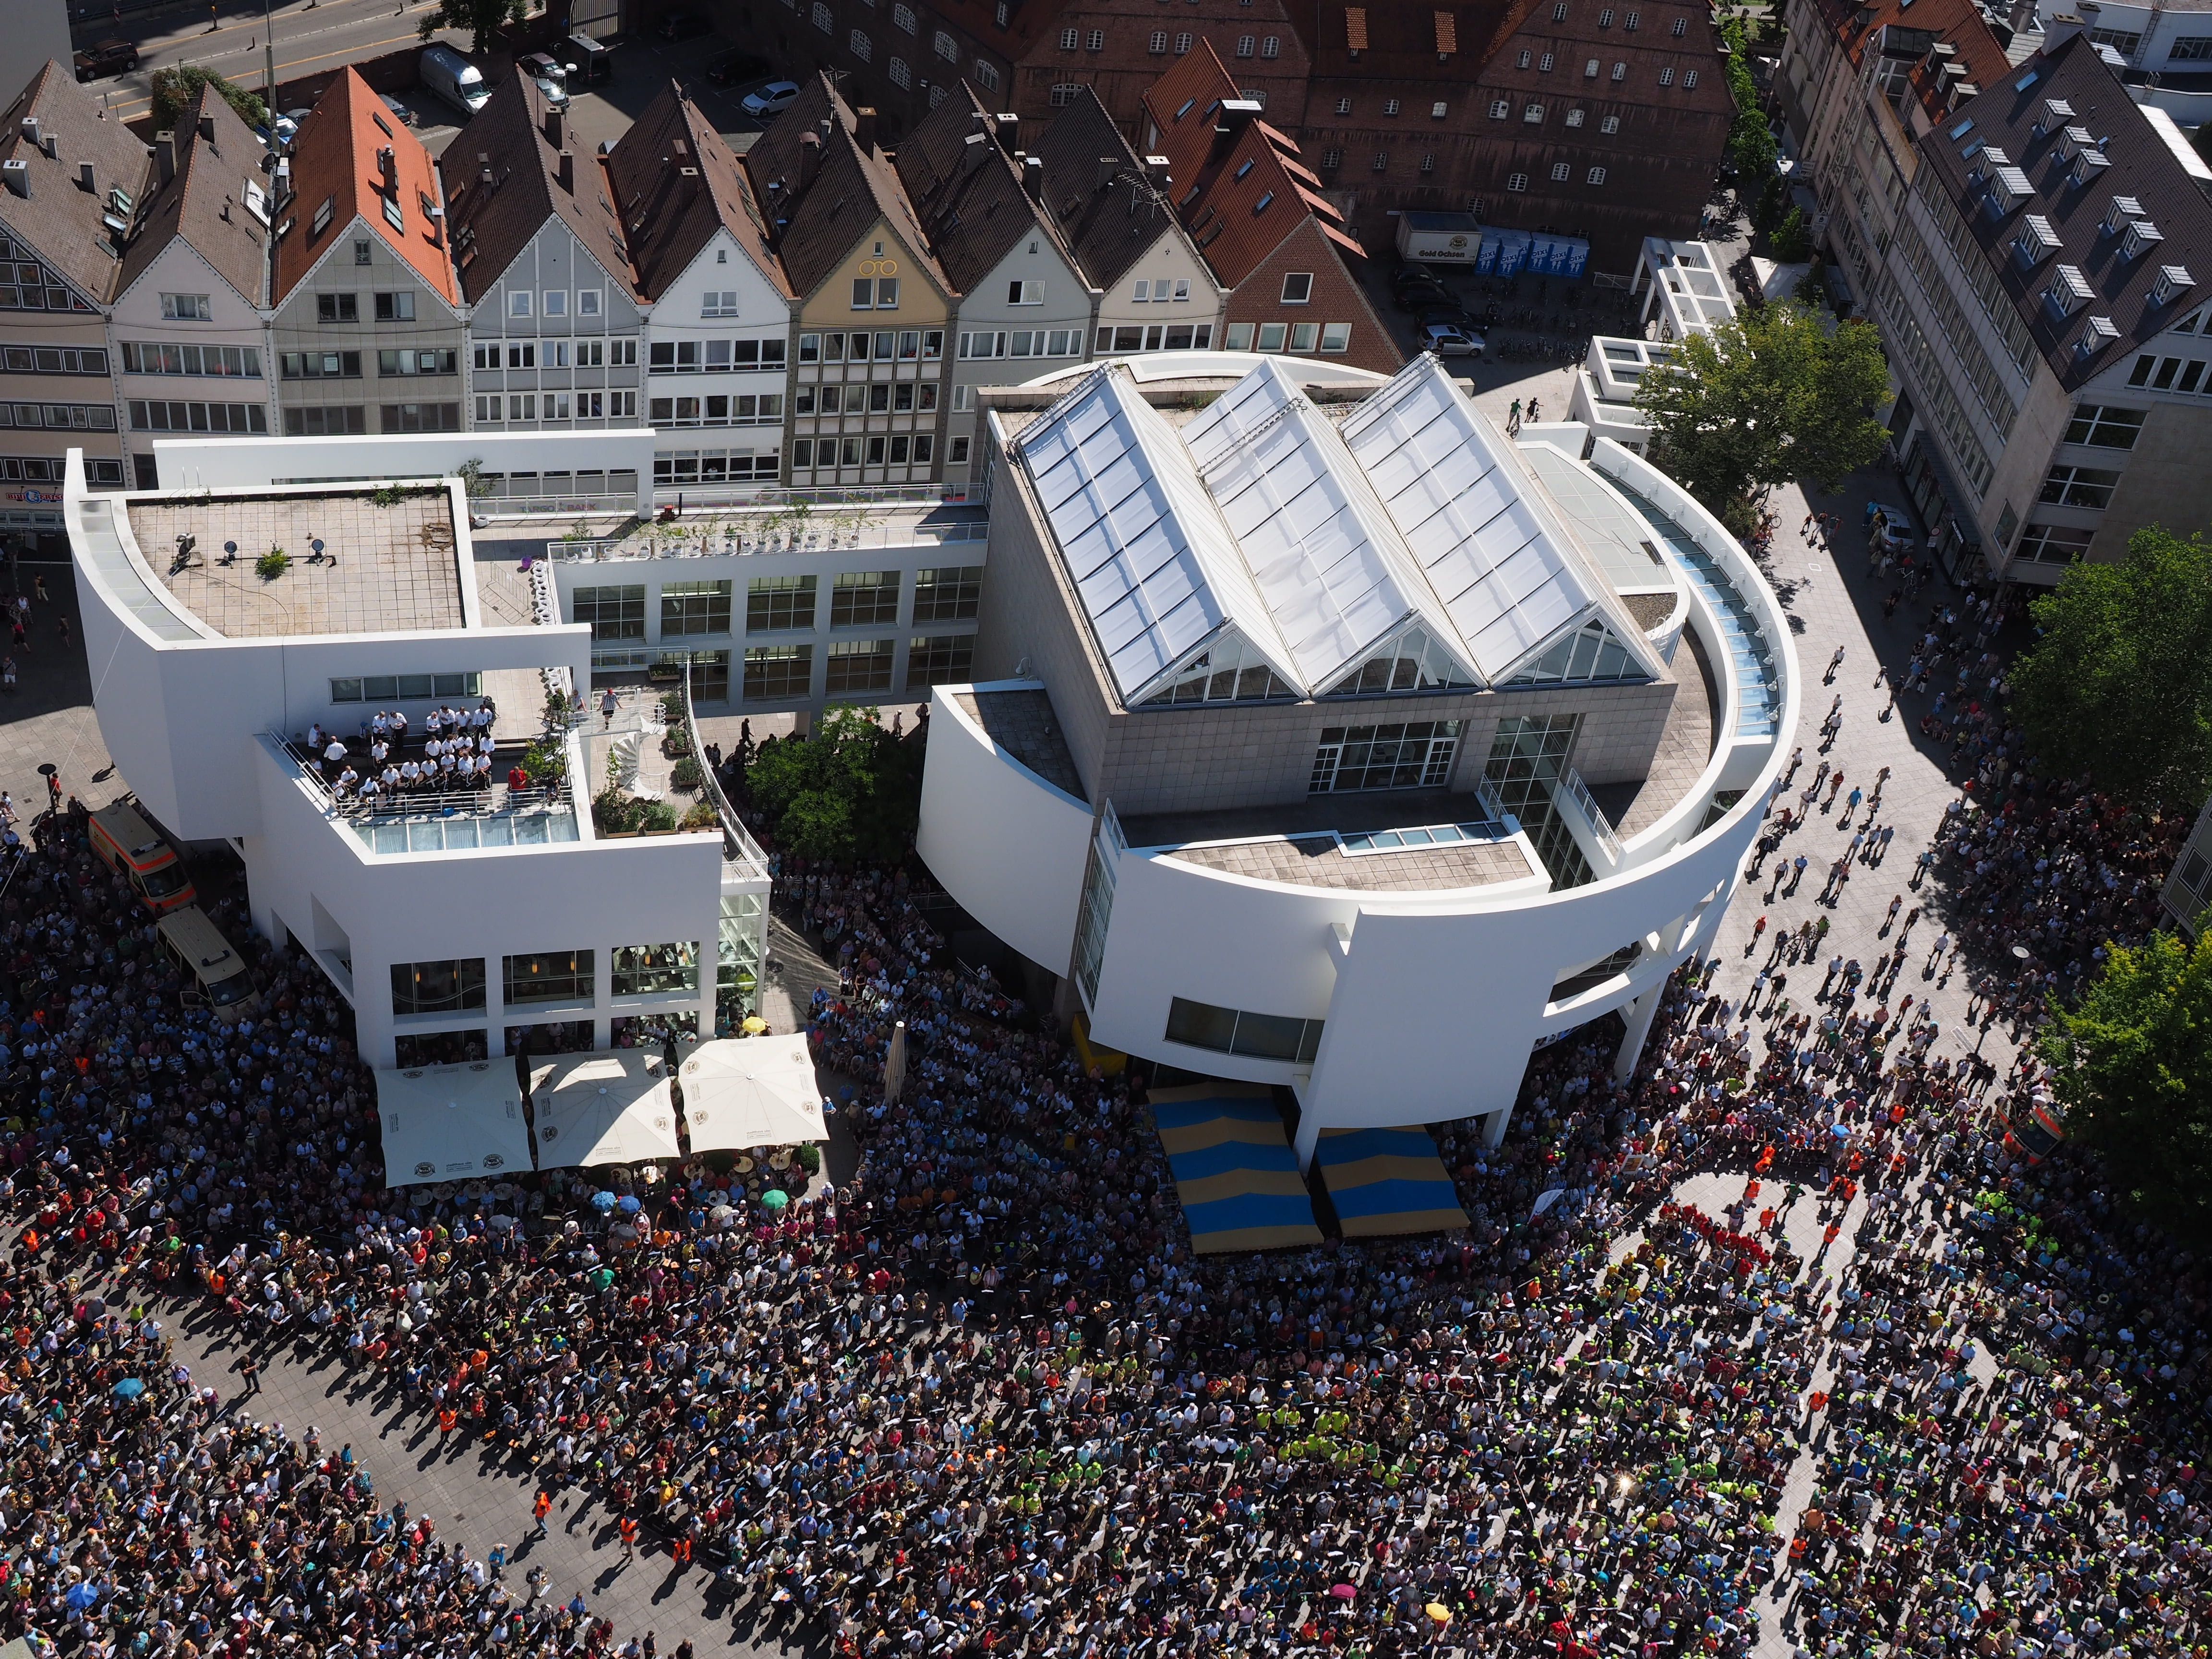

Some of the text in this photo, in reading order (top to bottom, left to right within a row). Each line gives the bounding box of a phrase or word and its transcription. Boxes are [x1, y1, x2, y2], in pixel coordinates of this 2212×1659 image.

[1479, 250, 1495, 258] DIXI
[1532, 249, 1548, 257] DIXI
[1551, 251, 1567, 259] DIXI
[1501, 254, 1517, 262] DIXI
[1570, 253, 1586, 262] DIXI
[699, 1243, 707, 1252] 32
